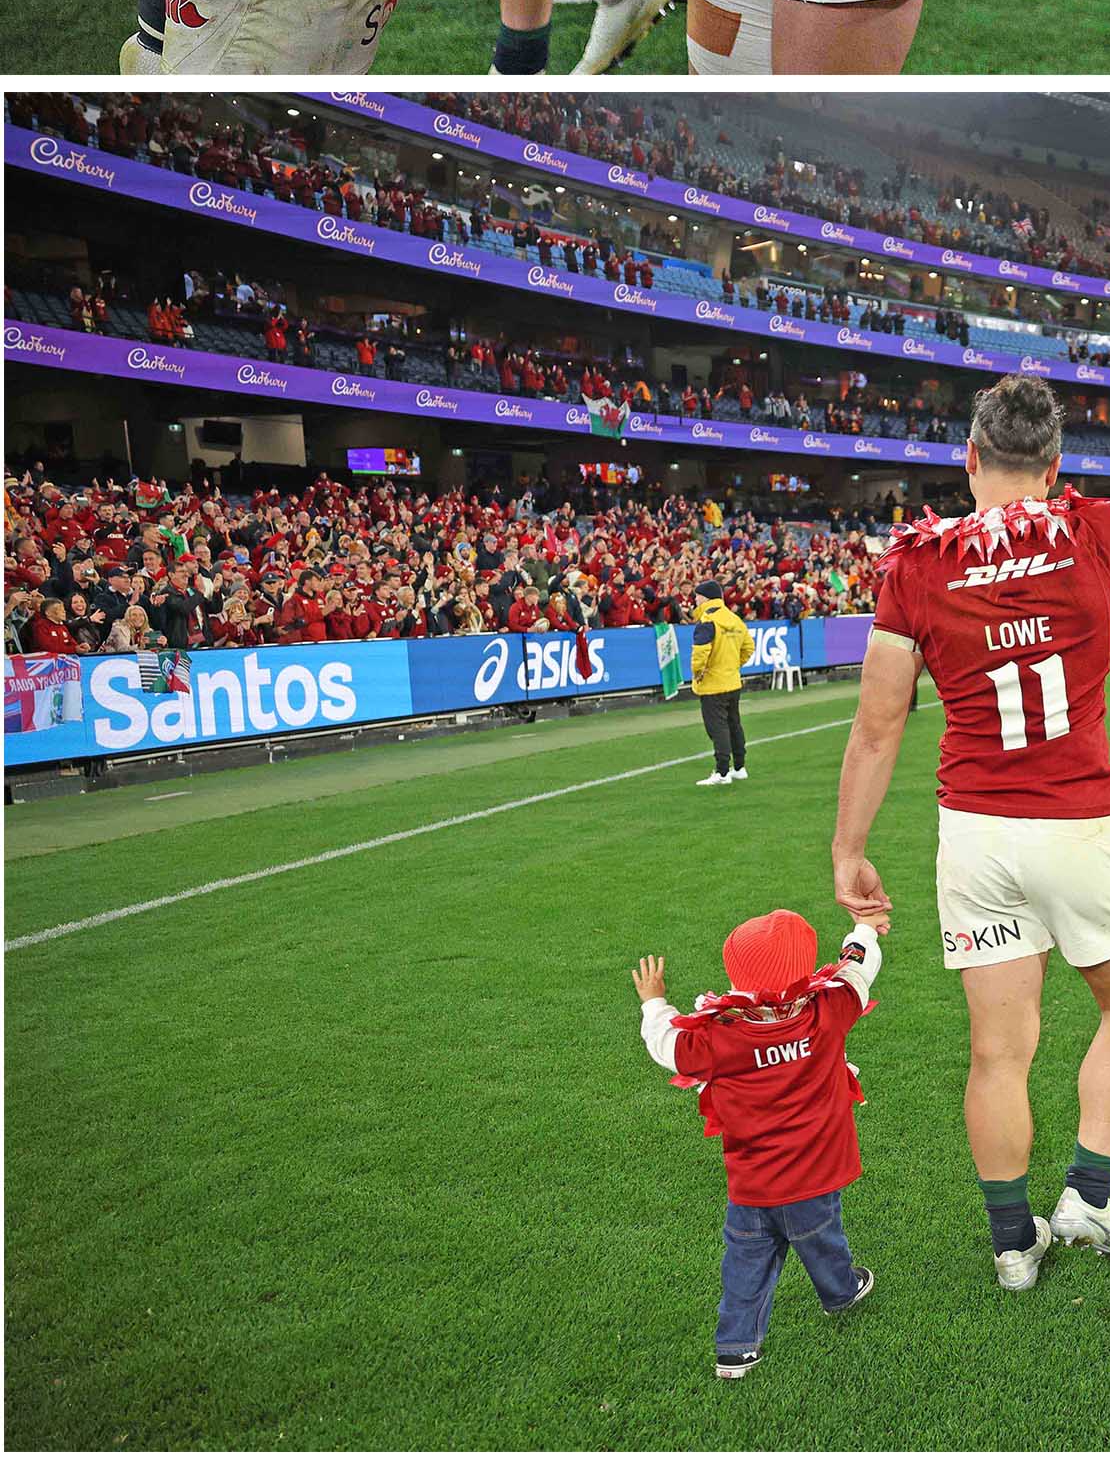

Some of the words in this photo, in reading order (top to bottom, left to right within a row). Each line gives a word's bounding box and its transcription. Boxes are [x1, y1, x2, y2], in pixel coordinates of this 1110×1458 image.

[434, 114, 481, 147] Cadbury
[523, 143, 568, 173] Cadbury
[608, 165, 649, 193] Cadbury
[684, 187, 721, 213] Cadbury
[30, 137, 115, 188] Cadbury
[190, 182, 257, 223] Cadbury
[317, 216, 375, 253] Cadbury
[428, 243, 481, 276] Cadbury
[527, 266, 574, 297] Cadbury
[614, 283, 657, 312] Cadbury
[695, 300, 735, 326] Cadbury
[4, 327, 66, 359] Cadbury
[128, 347, 186, 378] Cadbury
[237, 364, 288, 392] Cadbury
[331, 376, 376, 401] Cadbury
[416, 389, 458, 412] Cadbury
[495, 399, 533, 421] Cadbury
[962, 552, 1058, 588] DHL
[984, 616, 1053, 652] LOWE
[90, 651, 356, 749] Santos
[984, 653, 1071, 751] 11
[943, 919, 1022, 952] SOKIN
[753, 1037, 812, 1068] LOWE
